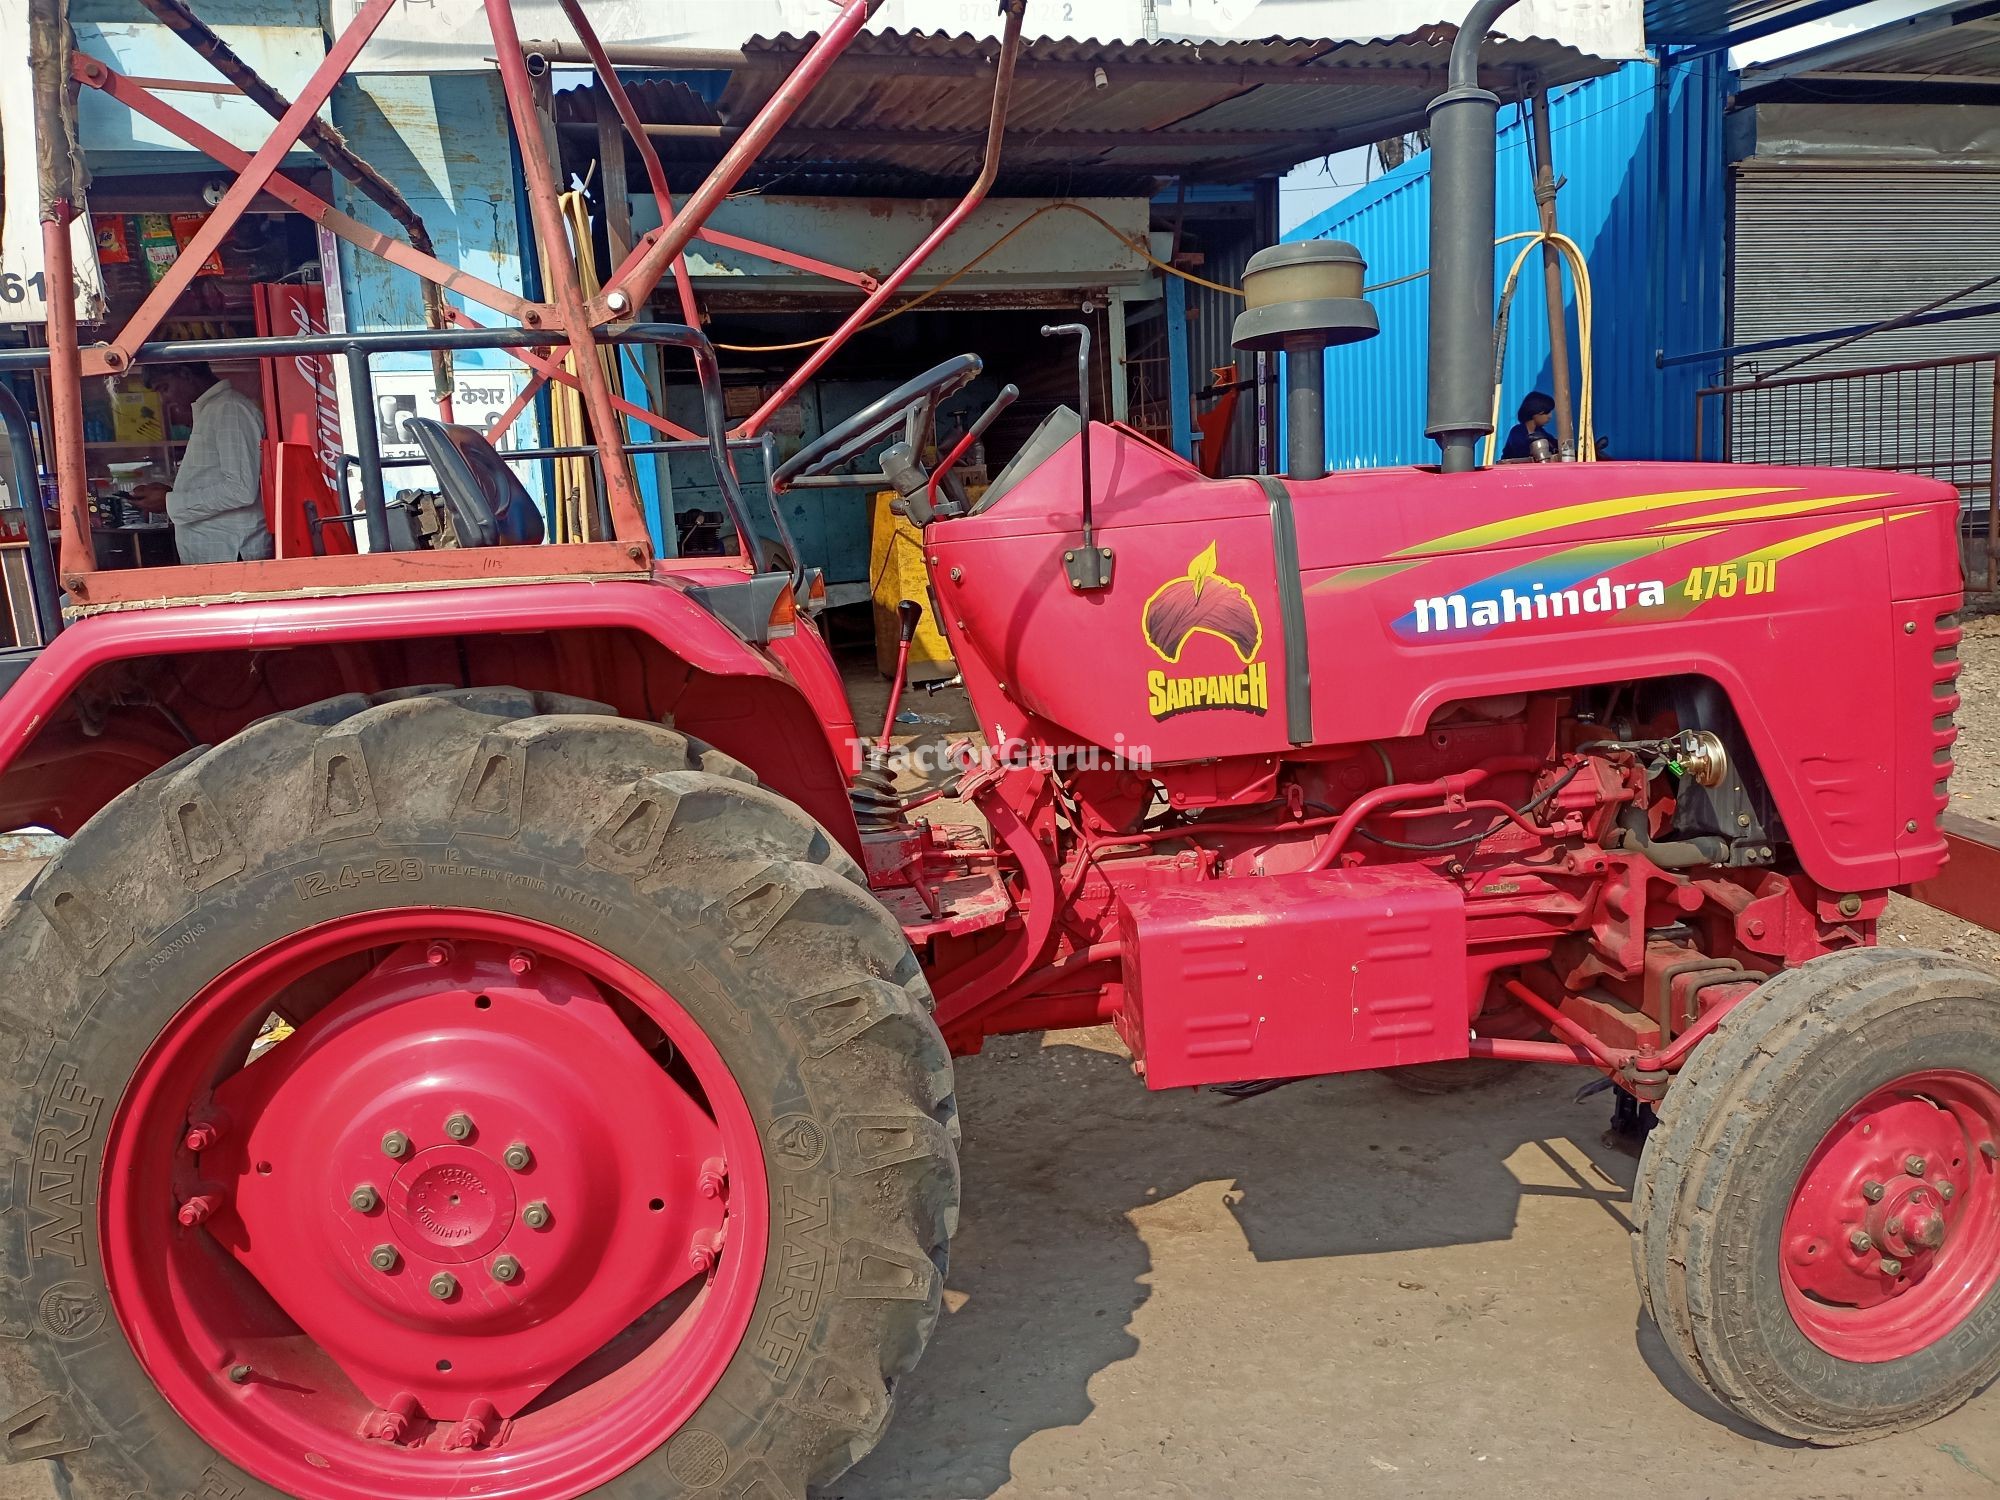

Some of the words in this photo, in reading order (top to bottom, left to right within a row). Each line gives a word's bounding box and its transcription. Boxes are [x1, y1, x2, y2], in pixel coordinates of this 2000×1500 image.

[0, 271, 80, 304] 61
[1683, 563, 1738, 601] 475
[1745, 559, 1776, 596] DI
[1147, 661, 1268, 719] SARPANCH
[293, 857, 424, 901] 12.4-28
[429, 864, 477, 876] TWELVE
[480, 869, 500, 880] PLY
[505, 873, 546, 891] RATING
[553, 885, 613, 917] NYLON
[28, 1063, 104, 1268] MRF
[757, 1183, 829, 1382] MRF
